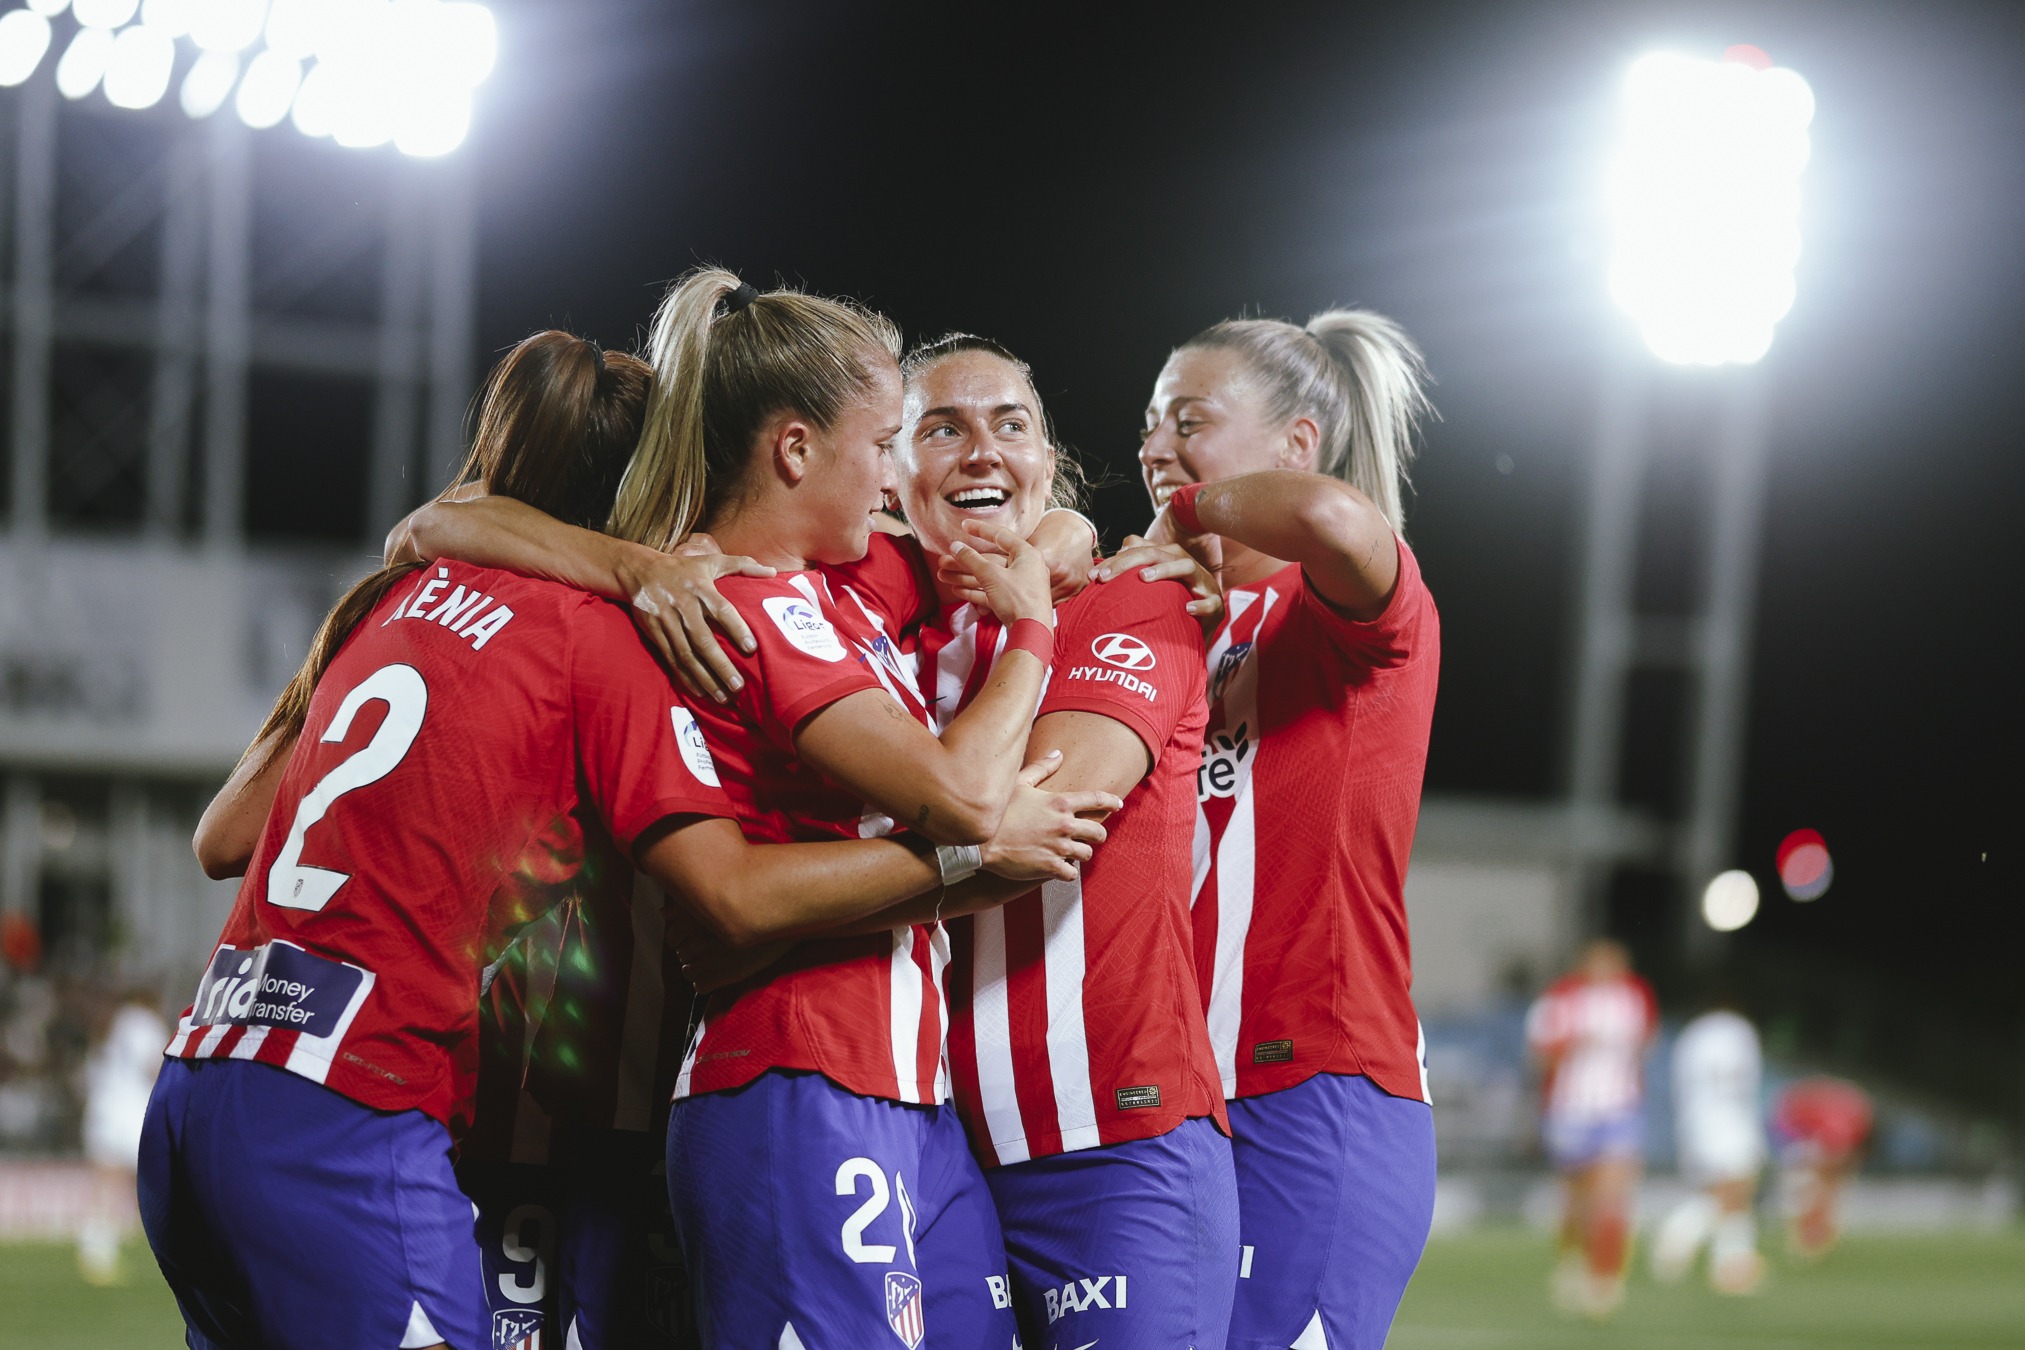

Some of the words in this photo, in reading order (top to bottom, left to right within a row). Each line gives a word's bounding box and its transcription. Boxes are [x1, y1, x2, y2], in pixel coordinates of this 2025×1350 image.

[1068, 666, 1158, 703] HYUNDAI
[267, 663, 428, 912] 2
[203, 957, 259, 1019] ria
[499, 1204, 556, 1303] 9
[1043, 1276, 1127, 1325] BAXI
